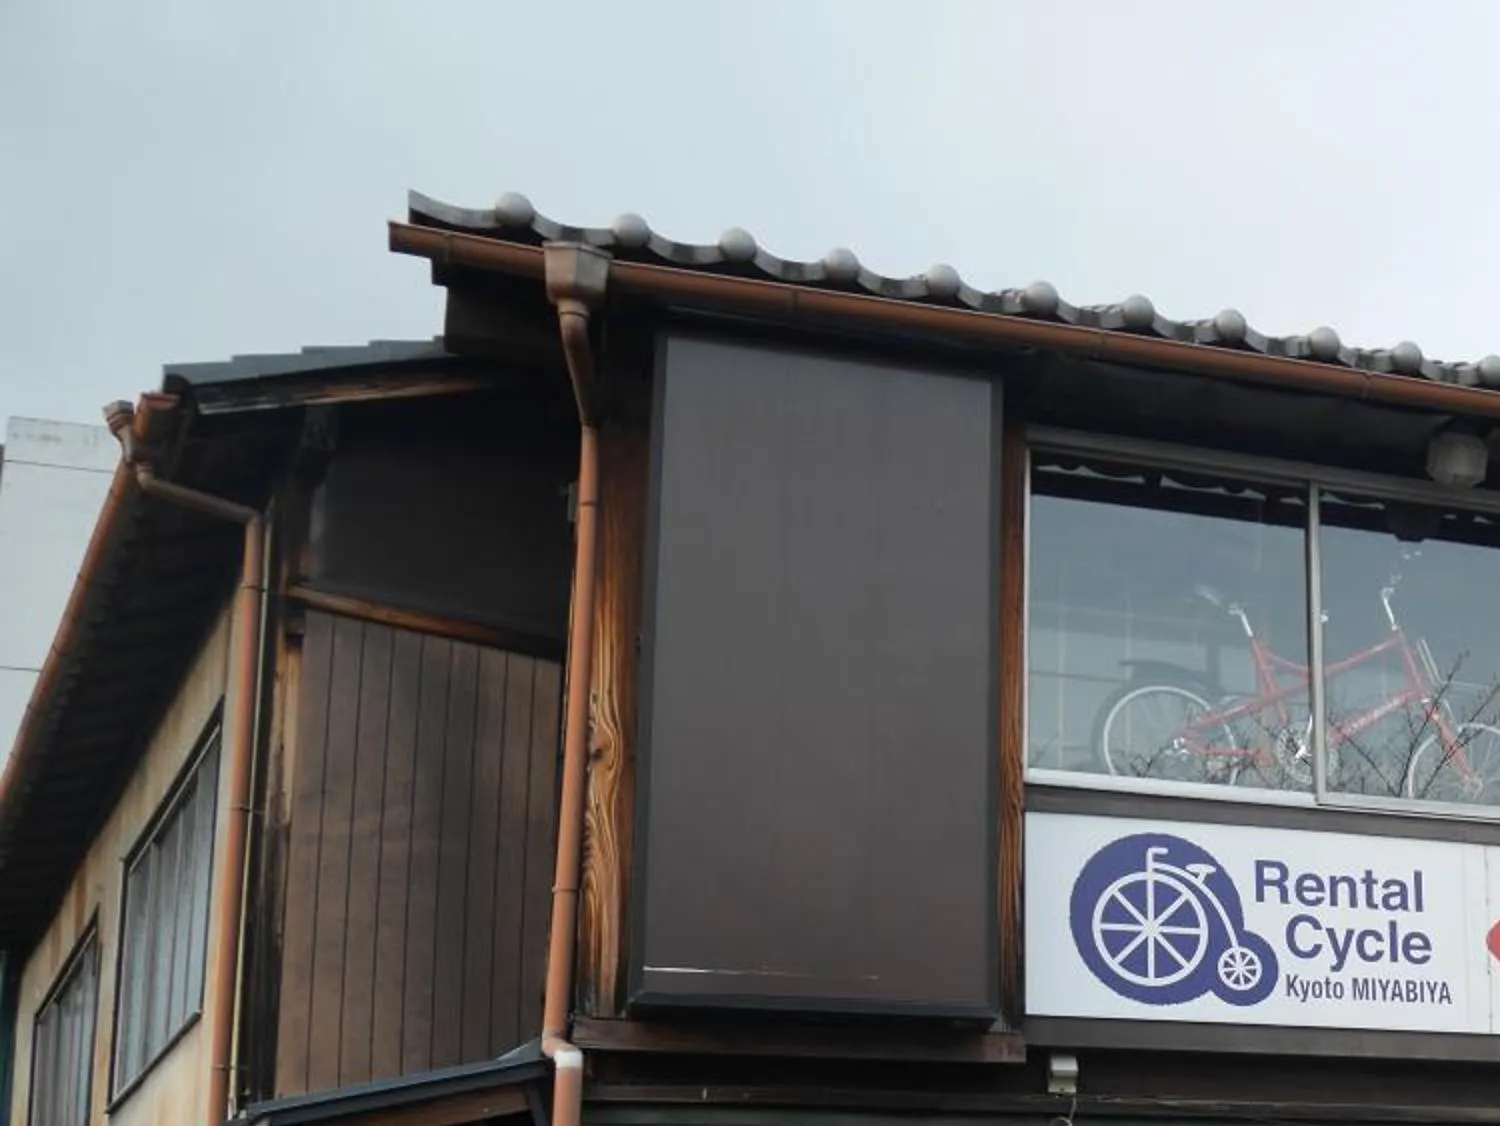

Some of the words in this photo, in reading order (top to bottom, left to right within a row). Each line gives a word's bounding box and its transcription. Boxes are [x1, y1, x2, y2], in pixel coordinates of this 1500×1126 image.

[1254, 859, 1424, 913] Rental
[1285, 914, 1433, 973] Cycle
[1285, 974, 1345, 1003] Kyoto
[1351, 977, 1453, 1005] MIYABIYA
